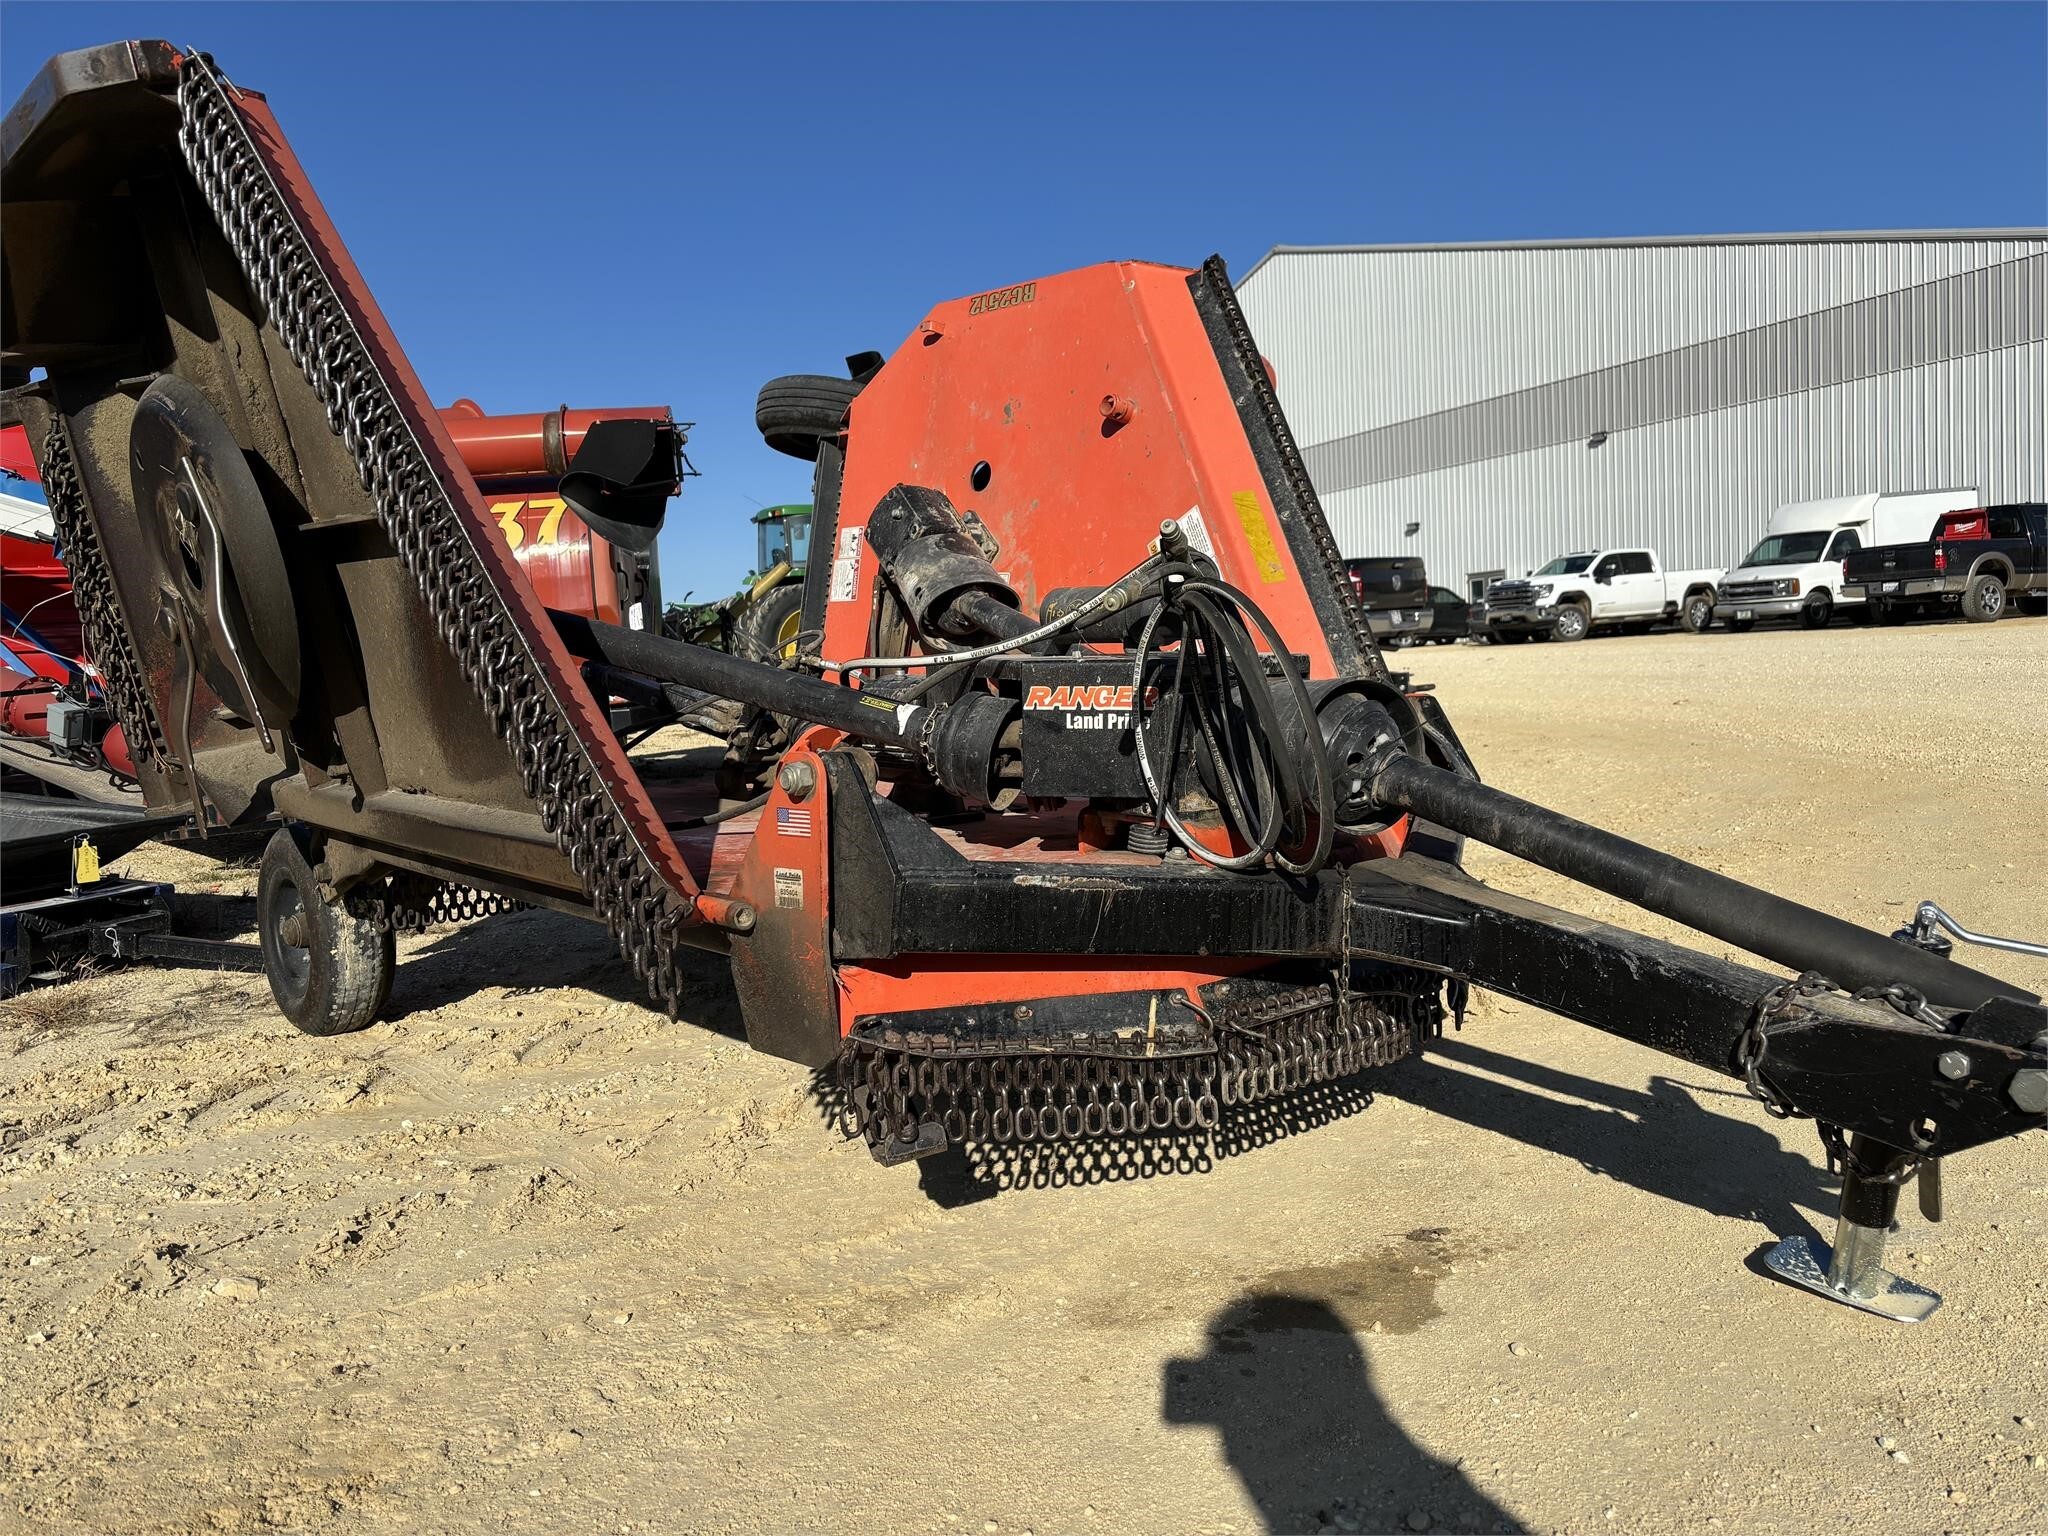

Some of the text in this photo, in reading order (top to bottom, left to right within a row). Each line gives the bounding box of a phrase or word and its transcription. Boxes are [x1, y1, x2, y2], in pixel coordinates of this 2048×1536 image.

[968, 282, 1037, 316] RC2512
[970, 647, 1000, 658] WINNER
[1066, 713, 1104, 730] Land
[1135, 730, 1146, 760] WINNER
